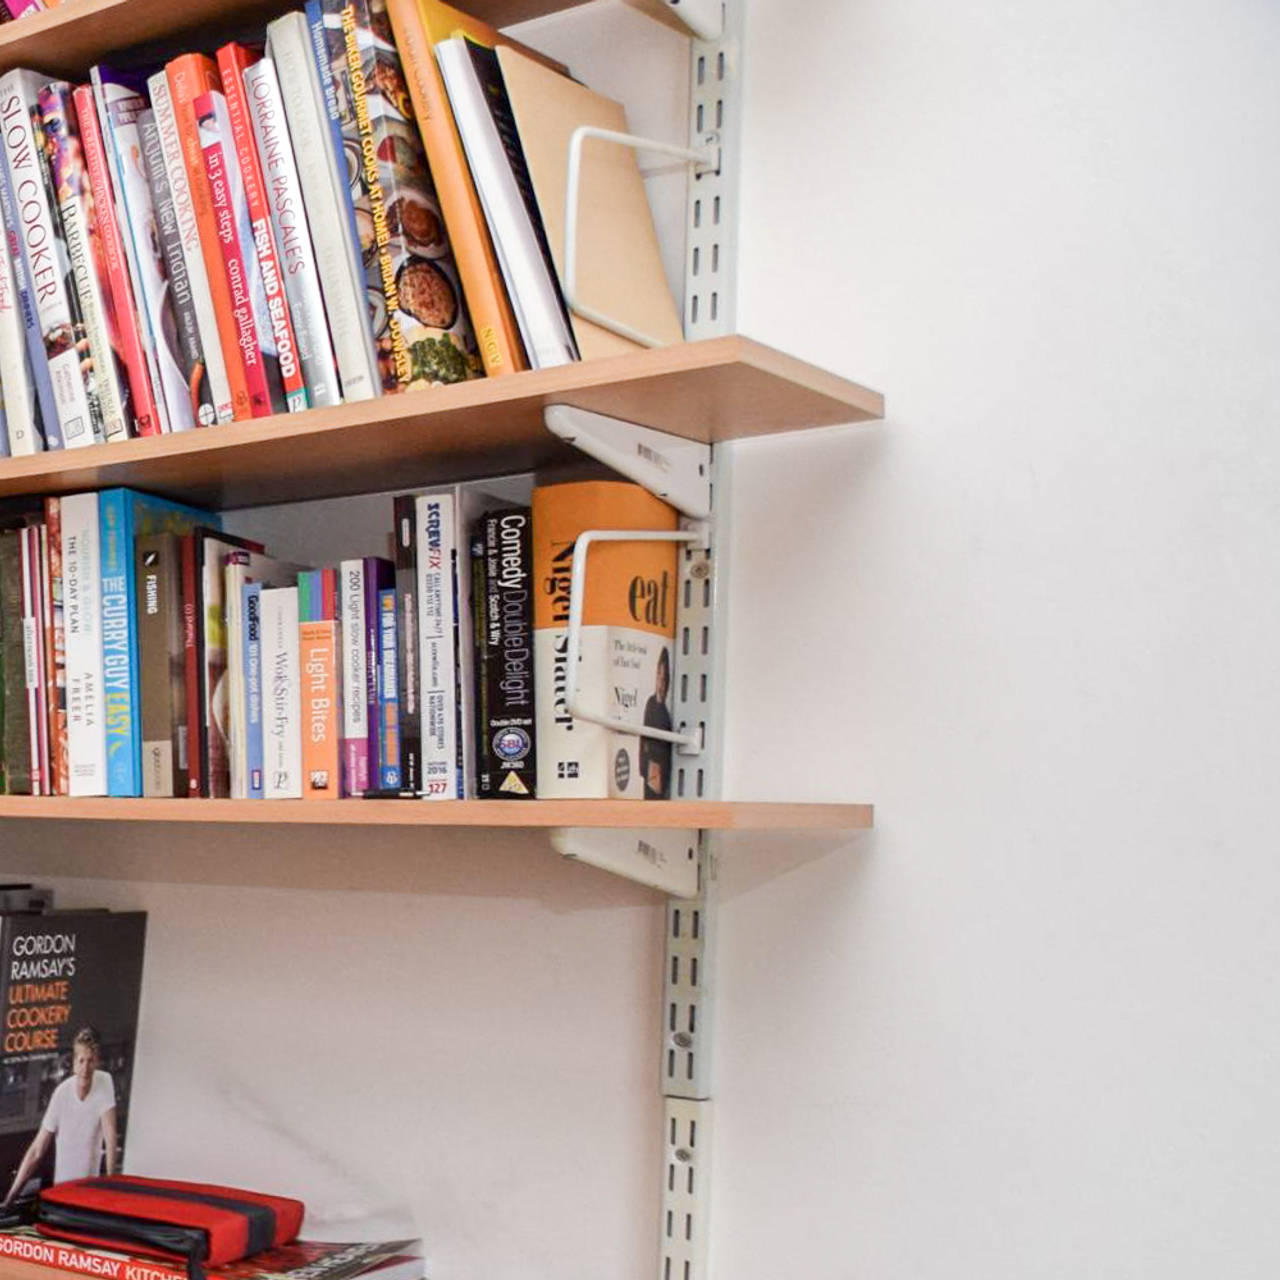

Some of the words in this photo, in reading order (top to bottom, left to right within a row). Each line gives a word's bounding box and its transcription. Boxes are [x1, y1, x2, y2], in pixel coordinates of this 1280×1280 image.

[341, 7, 355, 33] THE
[311, 22, 333, 85] Homemade
[324, 86, 340, 121] Bread
[345, 35, 363, 71] BIKER
[350, 71, 373, 136] GOURMET
[0, 94, 34, 171] SLOW
[152, 83, 181, 165] SUMMER
[209, 152, 222, 169] in
[251, 73, 287, 172] LORRAINE
[271, 175, 306, 277] PASCALE'S
[361, 137, 380, 182] COOKS
[211, 180, 228, 209] easy
[368, 184, 383, 202] AT
[160, 200, 176, 235] New
[218, 209, 237, 244] steps
[16, 178, 62, 305] COOKER
[61, 204, 97, 302] BARBECUE
[252, 218, 272, 257] FISH
[229, 259, 248, 305] conrad
[260, 258, 279, 294] AND
[379, 254, 397, 295] BRIAN
[235, 306, 259, 367] gallagher
[269, 297, 297, 379] SEAFOOD
[67, 536, 77, 556] THE
[427, 503, 441, 570] SCREWFIX
[500, 515, 527, 588] Comedy
[68, 561, 78, 600] 10-DAY
[146, 575, 157, 614] FISHING
[349, 571, 360, 590] 200
[629, 571, 668, 627] eat
[69, 605, 79, 633] PLAN
[102, 595, 127, 649] CURRY
[248, 596, 259, 641] GoodFood
[349, 594, 360, 620] Light
[488, 594, 497, 621] Scotch
[503, 591, 527, 648] Double
[351, 623, 360, 645] slow
[105, 655, 129, 689] GUY
[308, 648, 327, 692] Light
[351, 649, 361, 683] cooker
[500, 648, 529, 706] Delight
[71, 678, 81, 722] FREER
[84, 672, 95, 727] AMELIA
[105, 693, 130, 736] EASY
[350, 687, 362, 723] recipes
[614, 686, 638, 711] Nigel
[311, 698, 330, 742] Bites
[428, 783, 446, 793] 127
[13, 934, 76, 955] GORDON
[11, 957, 75, 980] RAMSAY'S
[9, 981, 69, 1004] ULTIMATE
[7, 1005, 71, 1028] COOKERY
[4, 1029, 58, 1052] COURSE
[57, 1251, 121, 1278] RAMSAY
